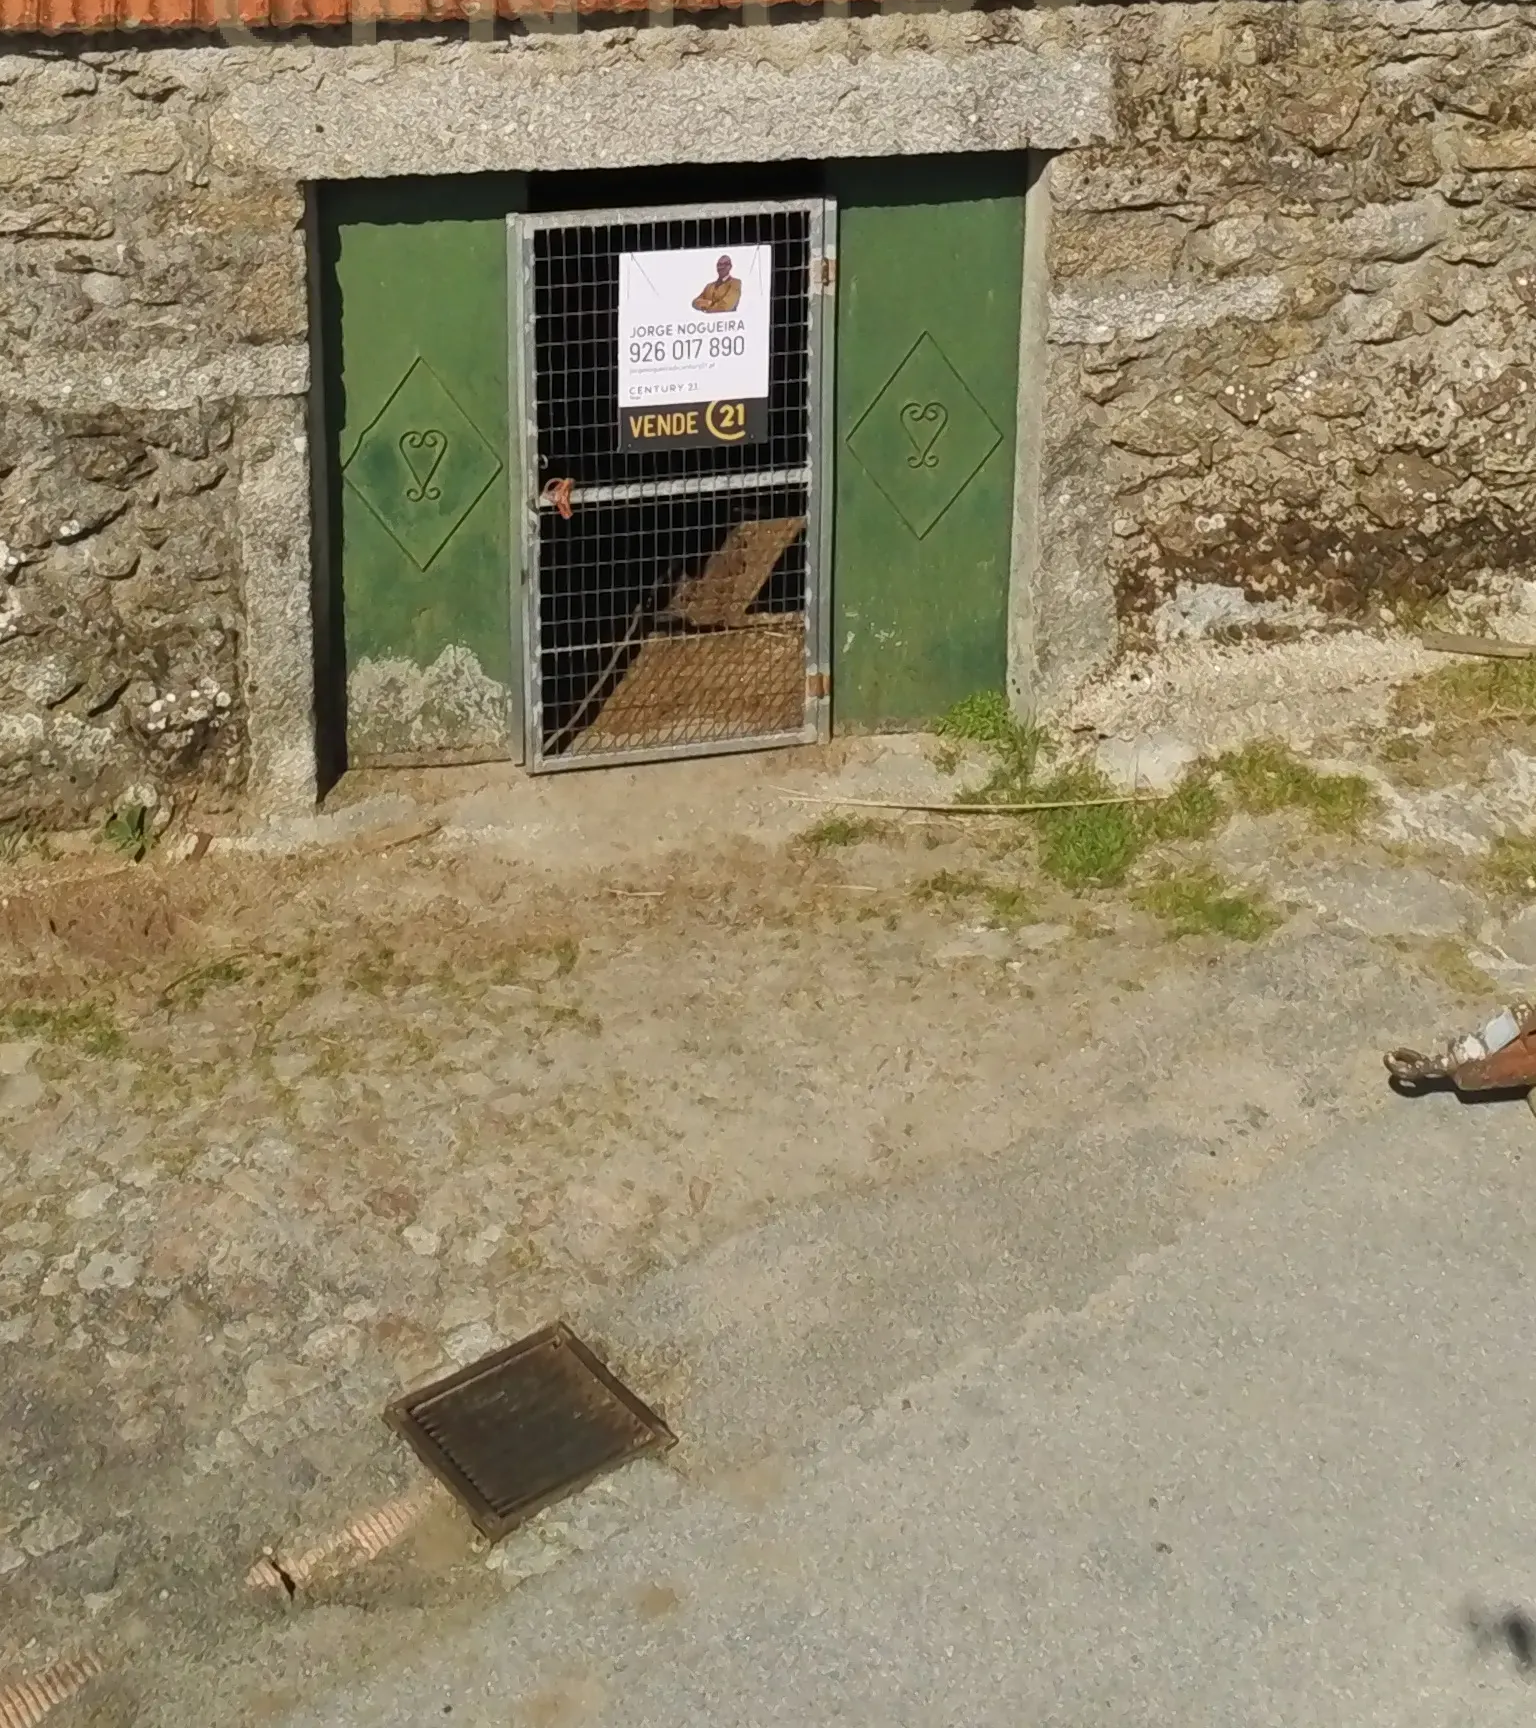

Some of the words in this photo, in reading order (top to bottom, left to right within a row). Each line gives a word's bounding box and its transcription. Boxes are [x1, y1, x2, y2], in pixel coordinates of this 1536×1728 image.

[630, 325, 673, 338] JORGE
[677, 320, 745, 334] NOGUEIRA
[629, 341, 666, 363] 926
[672, 339, 703, 360] 017
[709, 335, 745, 358] 890
[629, 384, 684, 395] CENTURY
[687, 382, 698, 391] 21
[629, 411, 699, 438] VENDE
